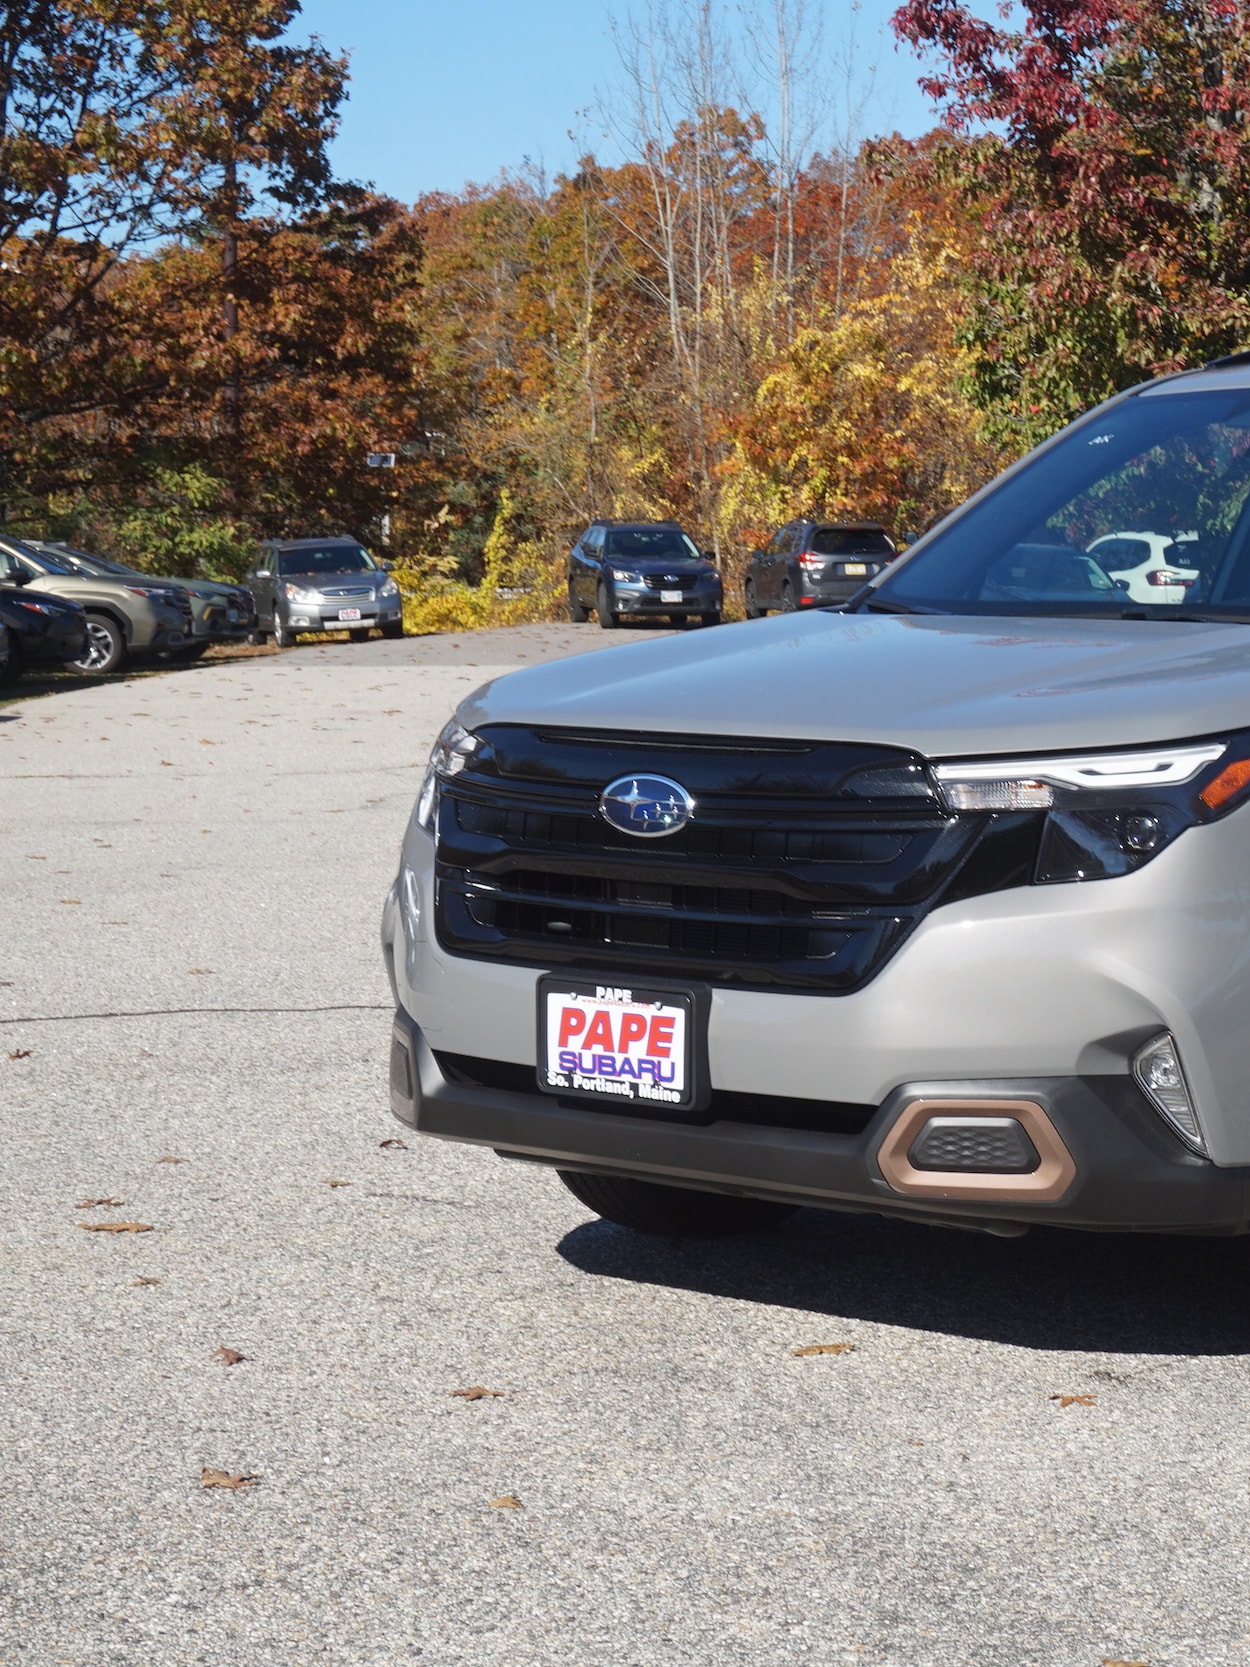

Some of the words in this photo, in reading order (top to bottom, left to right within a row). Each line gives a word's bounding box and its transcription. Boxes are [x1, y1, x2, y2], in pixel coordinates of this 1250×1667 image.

[595, 986, 633, 1003] PAPE
[557, 1007, 677, 1059] PAPE
[558, 1050, 676, 1084] SUBARU
[547, 1071, 569, 1088] So.
[572, 1074, 635, 1099] Portland,
[638, 1083, 681, 1104] Maine
